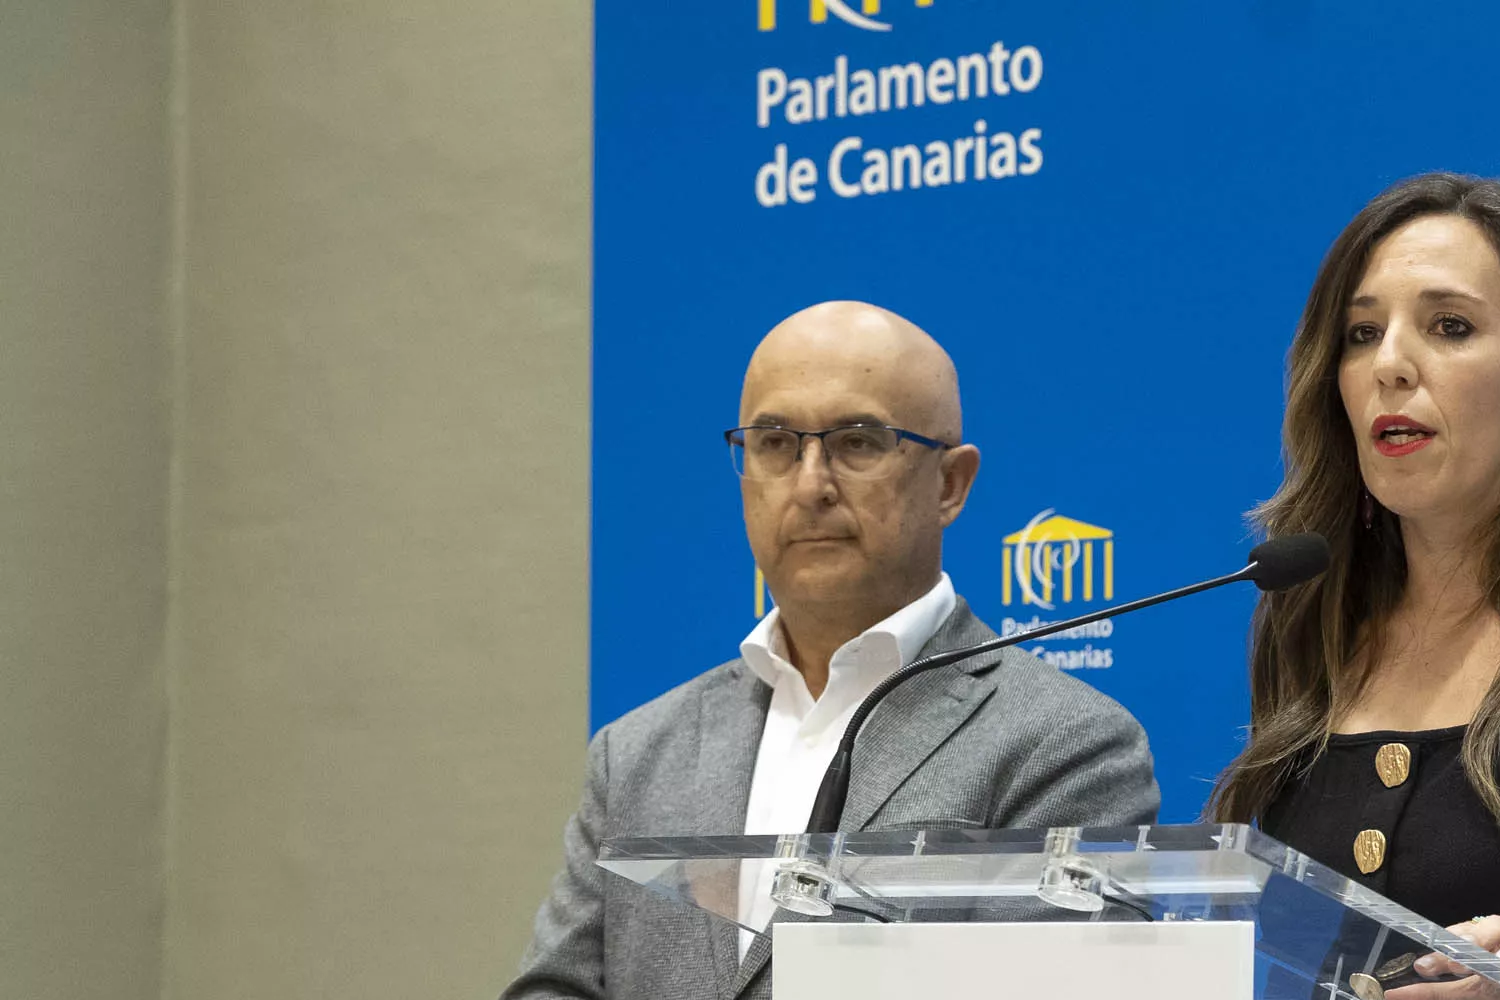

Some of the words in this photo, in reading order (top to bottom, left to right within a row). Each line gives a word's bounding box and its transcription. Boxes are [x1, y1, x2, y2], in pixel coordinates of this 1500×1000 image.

[756, 41, 1043, 128] Parlamento
[755, 143, 818, 208] de
[827, 119, 1044, 198] Canarias
